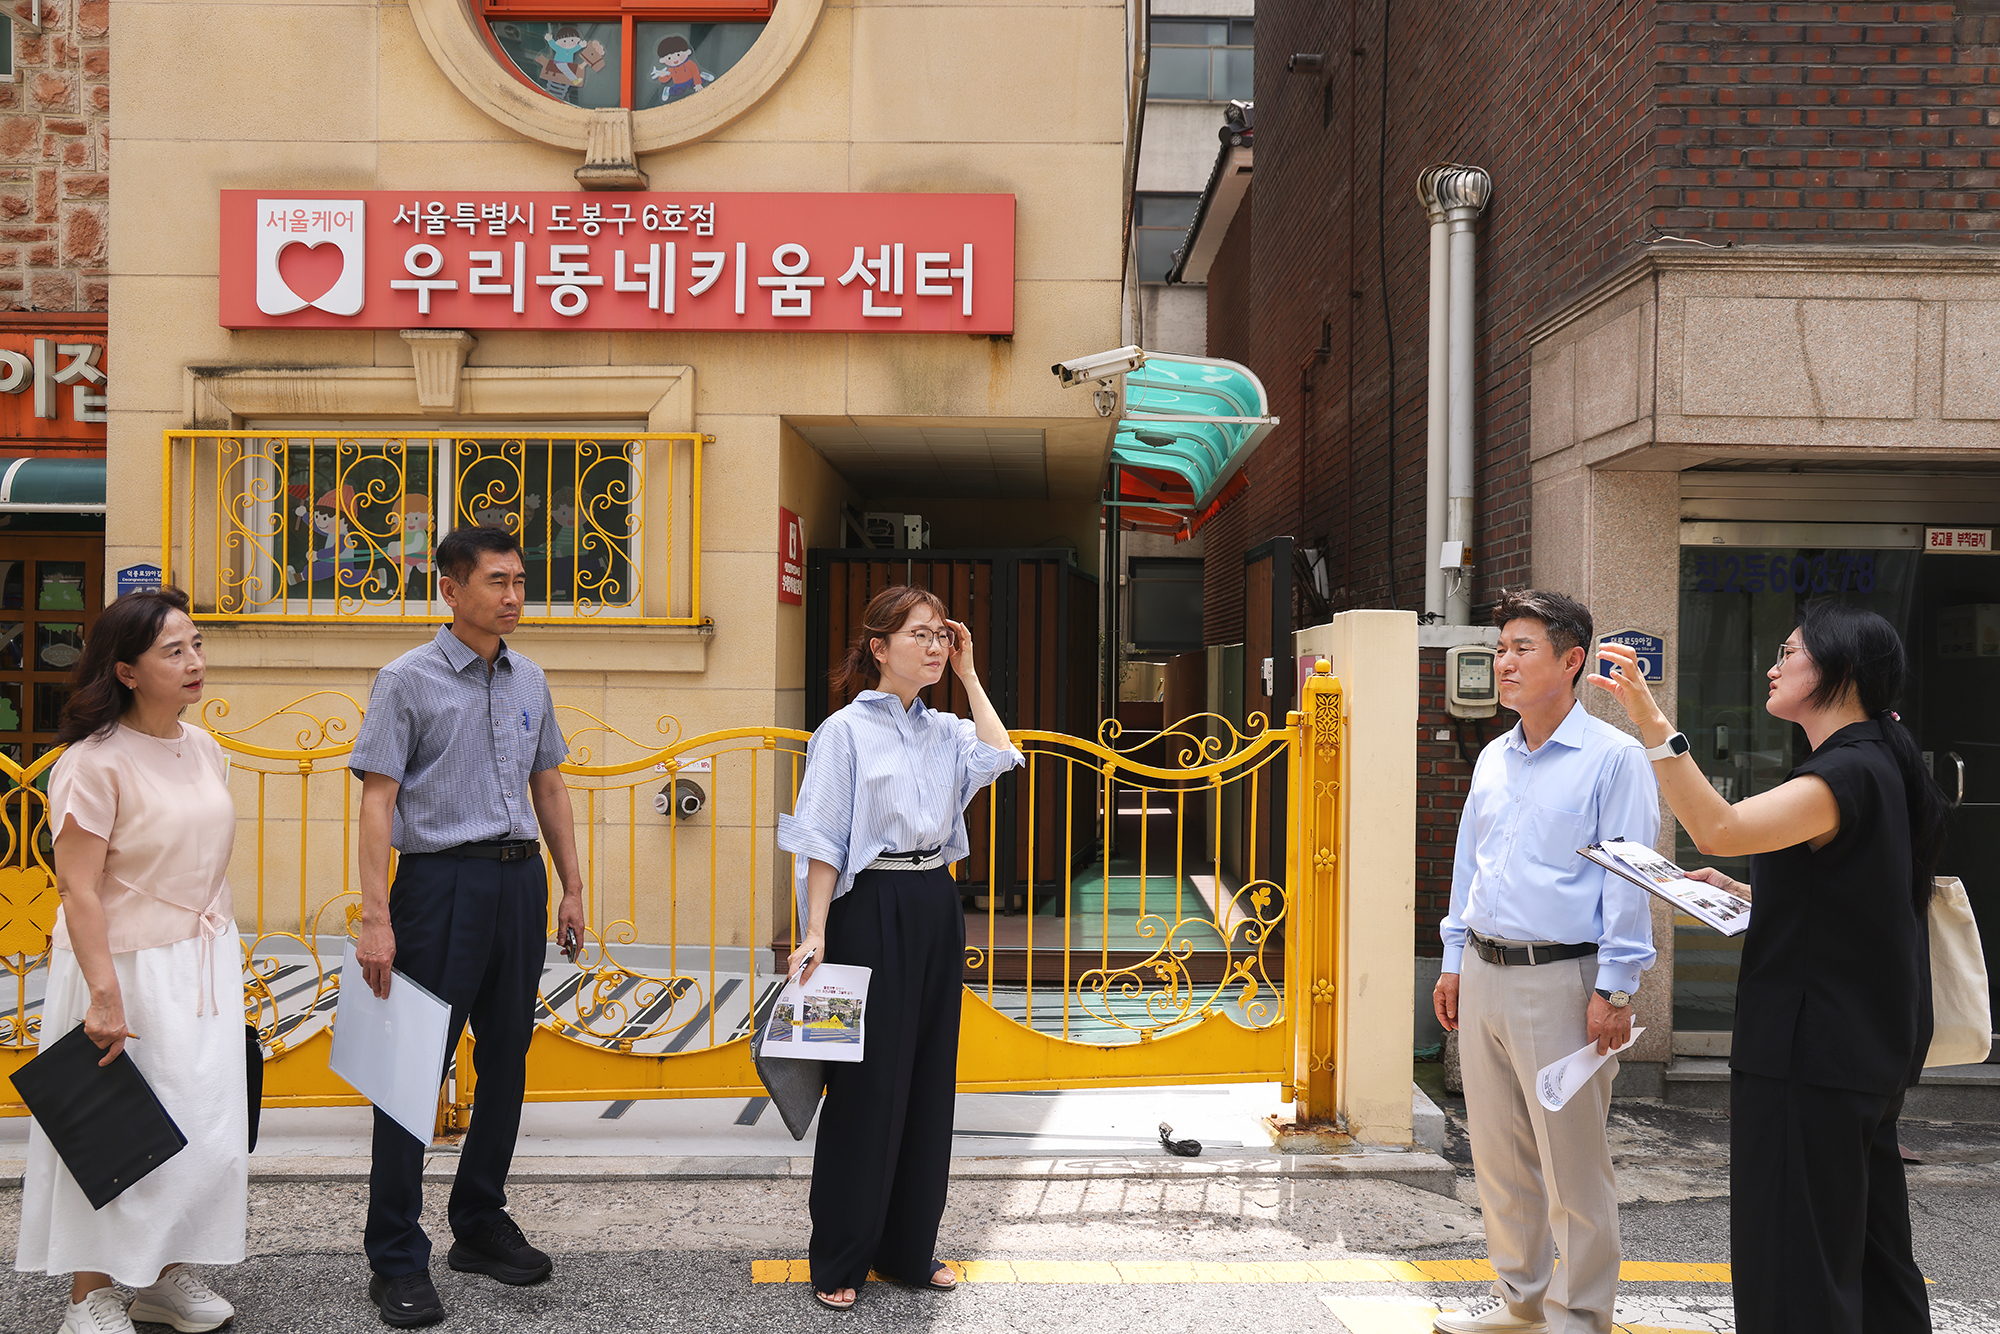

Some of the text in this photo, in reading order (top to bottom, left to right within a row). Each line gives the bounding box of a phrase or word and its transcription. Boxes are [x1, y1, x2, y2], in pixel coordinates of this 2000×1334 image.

[266, 208, 354, 233] 서울케어
[392, 200, 715, 237] 서울특별시 도봉구 6호점
[1931, 531, 1986, 548] 광고물 부착금지
[1694, 554, 1876, 594] 창2동603-78
